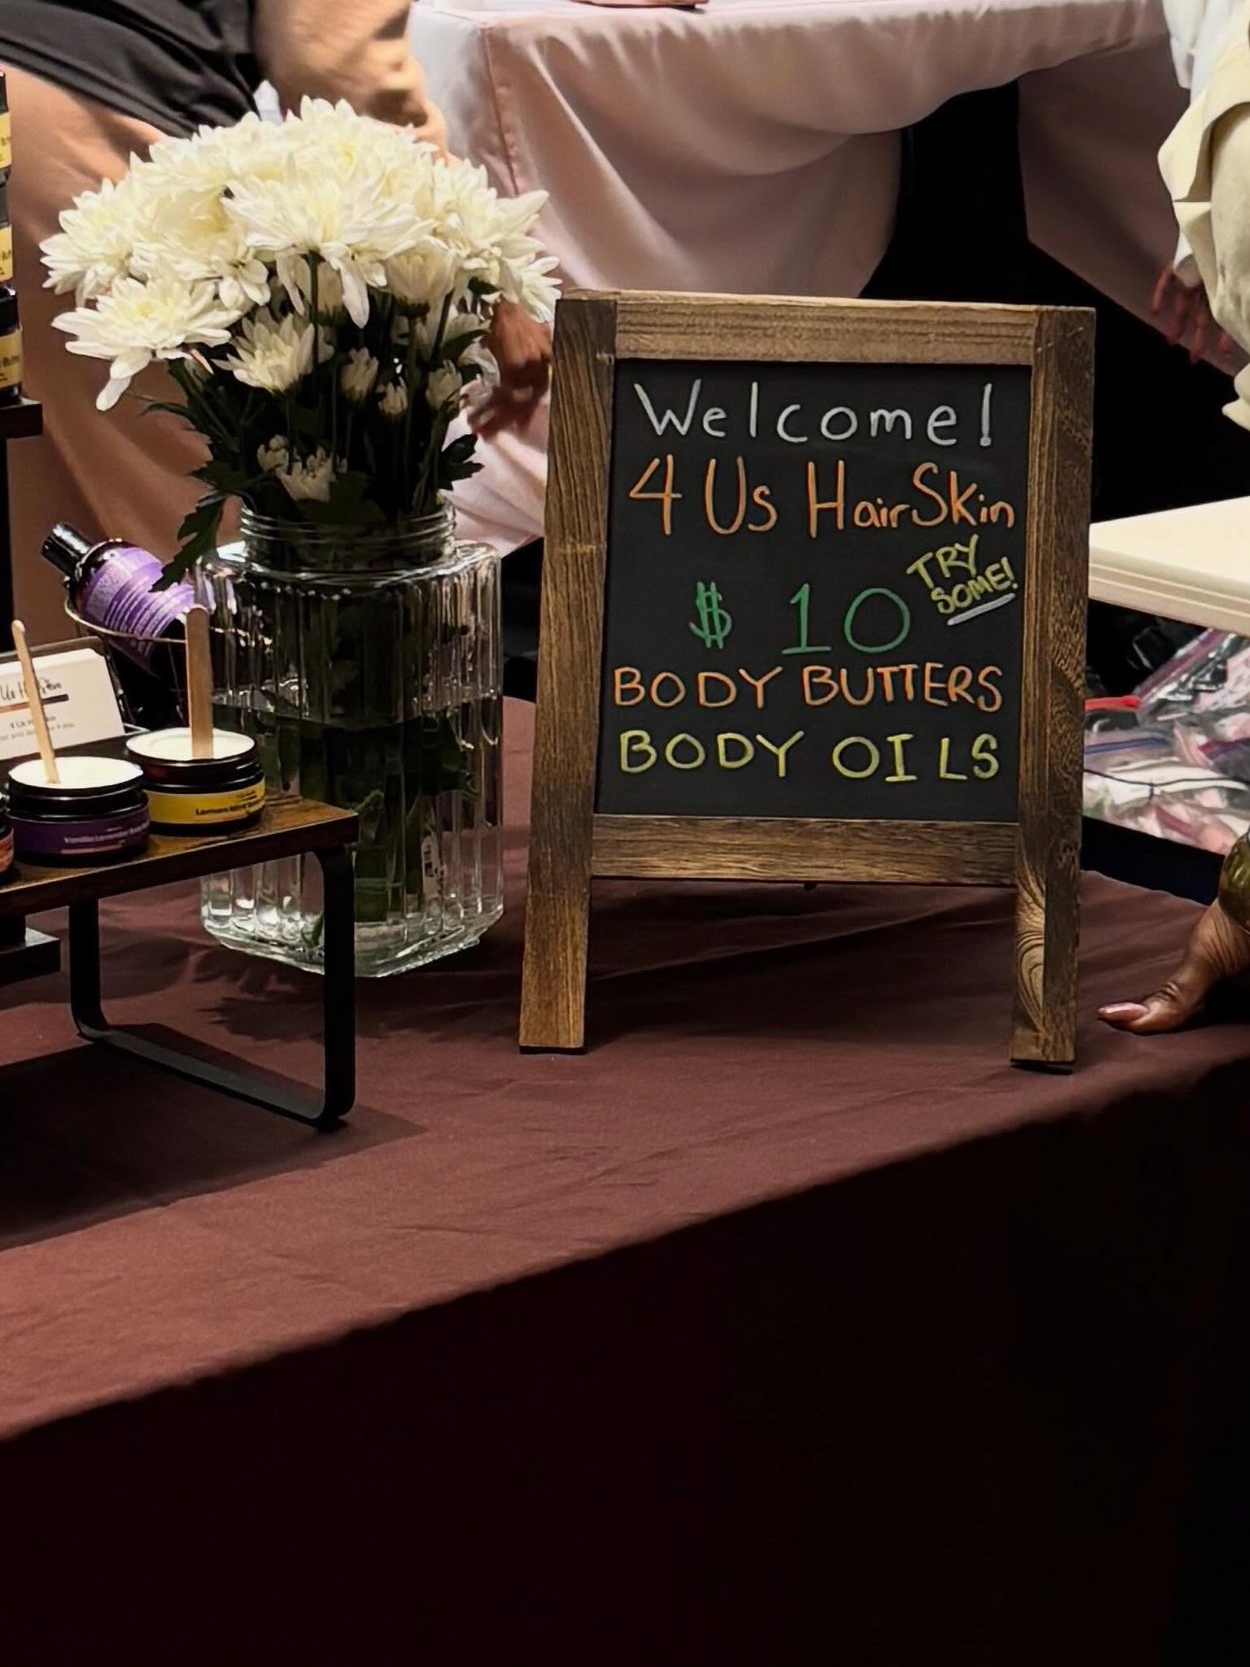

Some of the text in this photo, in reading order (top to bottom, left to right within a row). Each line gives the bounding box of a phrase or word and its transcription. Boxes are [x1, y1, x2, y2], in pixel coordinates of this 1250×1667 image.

[634, 379, 992, 447] Welcome!
[628, 454, 683, 536] 4
[704, 456, 778, 535] Us
[906, 533, 979, 590] TRY
[931, 556, 1019, 615] SOME!
[689, 581, 911, 654] $ 10
[613, 662, 1003, 713] BODY BUTTERS
[620, 729, 999, 782] BODY OILS
